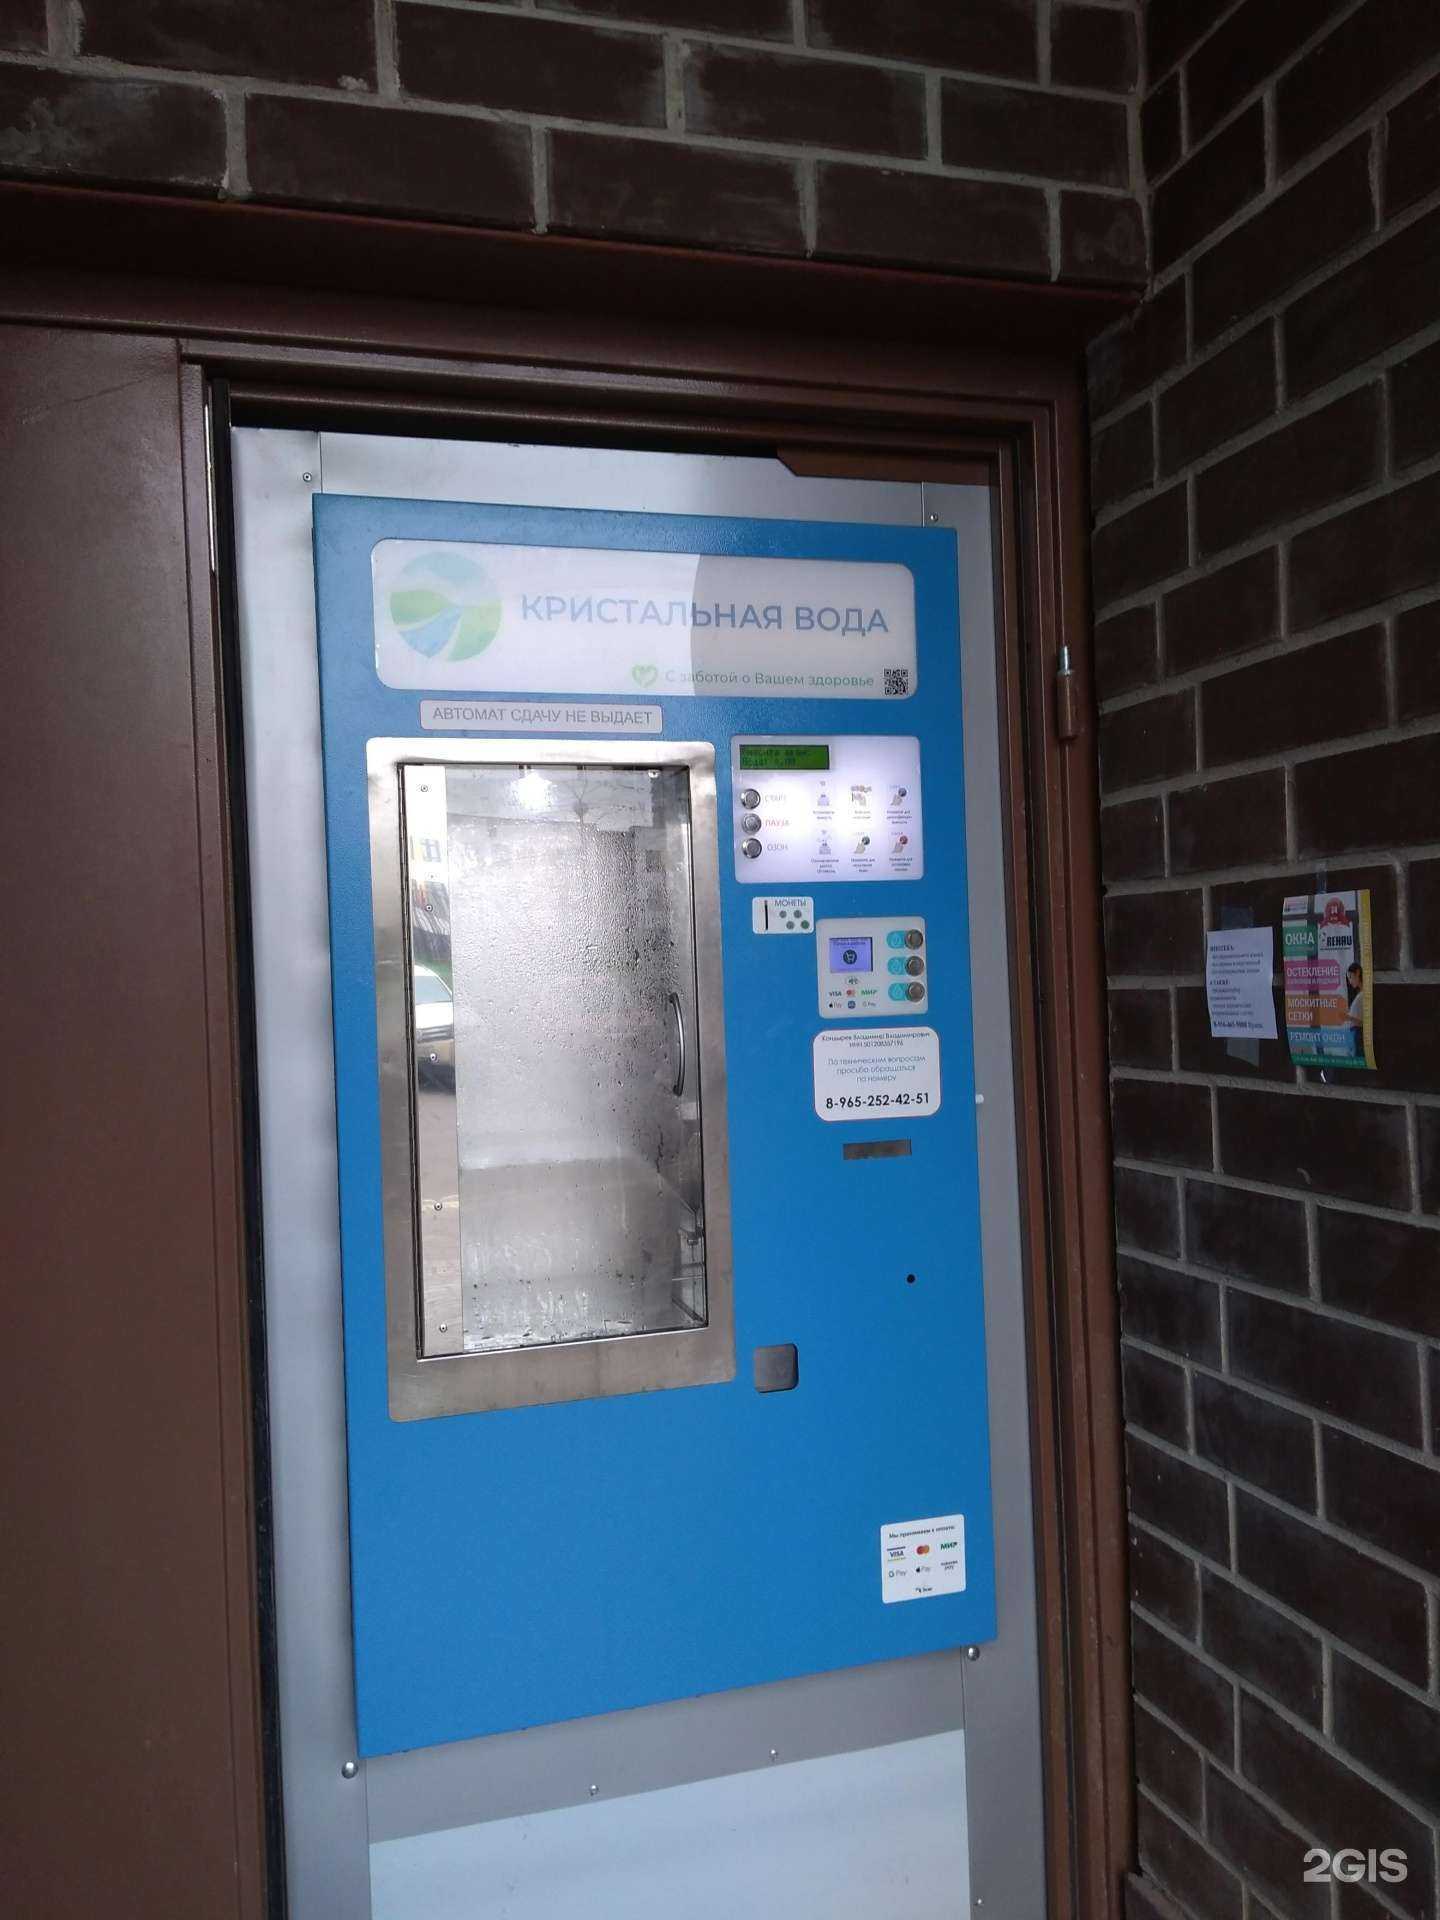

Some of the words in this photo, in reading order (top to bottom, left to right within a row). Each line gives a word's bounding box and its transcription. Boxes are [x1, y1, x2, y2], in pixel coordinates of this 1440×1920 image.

[521, 594, 783, 630] КРИСТАЛЬНАЯ
[795, 606, 889, 637] ВОДА
[665, 670, 676, 683] С
[680, 670, 738, 685] заботой
[742, 675, 750, 684] о
[755, 672, 803, 686] Вашем
[808, 674, 874, 689] здоровье
[433, 708, 507, 722] АВТОМАТ
[511, 709, 561, 725] СДАЧУ
[566, 710, 586, 723] НЕ
[592, 711, 652, 727] ВЫДАЕТ
[765, 818, 790, 827] ПАУЗА
[774, 899, 807, 907] МОНЕТЫ
[1285, 932, 1315, 946] ОКНА
[1327, 935, 1352, 947] REHAU
[1287, 966, 1339, 977] ОСТЕКЛЕНИЕ
[1288, 998, 1337, 1009] МОСКИТНЫЕ
[1288, 1011, 1313, 1021] СЕТКИ
[1290, 1031, 1320, 1042] РЕМОНТ
[888, 1055, 925, 1063] вопросам
[837, 1066, 868, 1075] просьба
[871, 1065, 915, 1073] обращаться
[868, 1075, 897, 1083] номеру
[826, 1092, 929, 1109] 8-965-252-42-51
[941, 1541, 957, 1550] МИР
